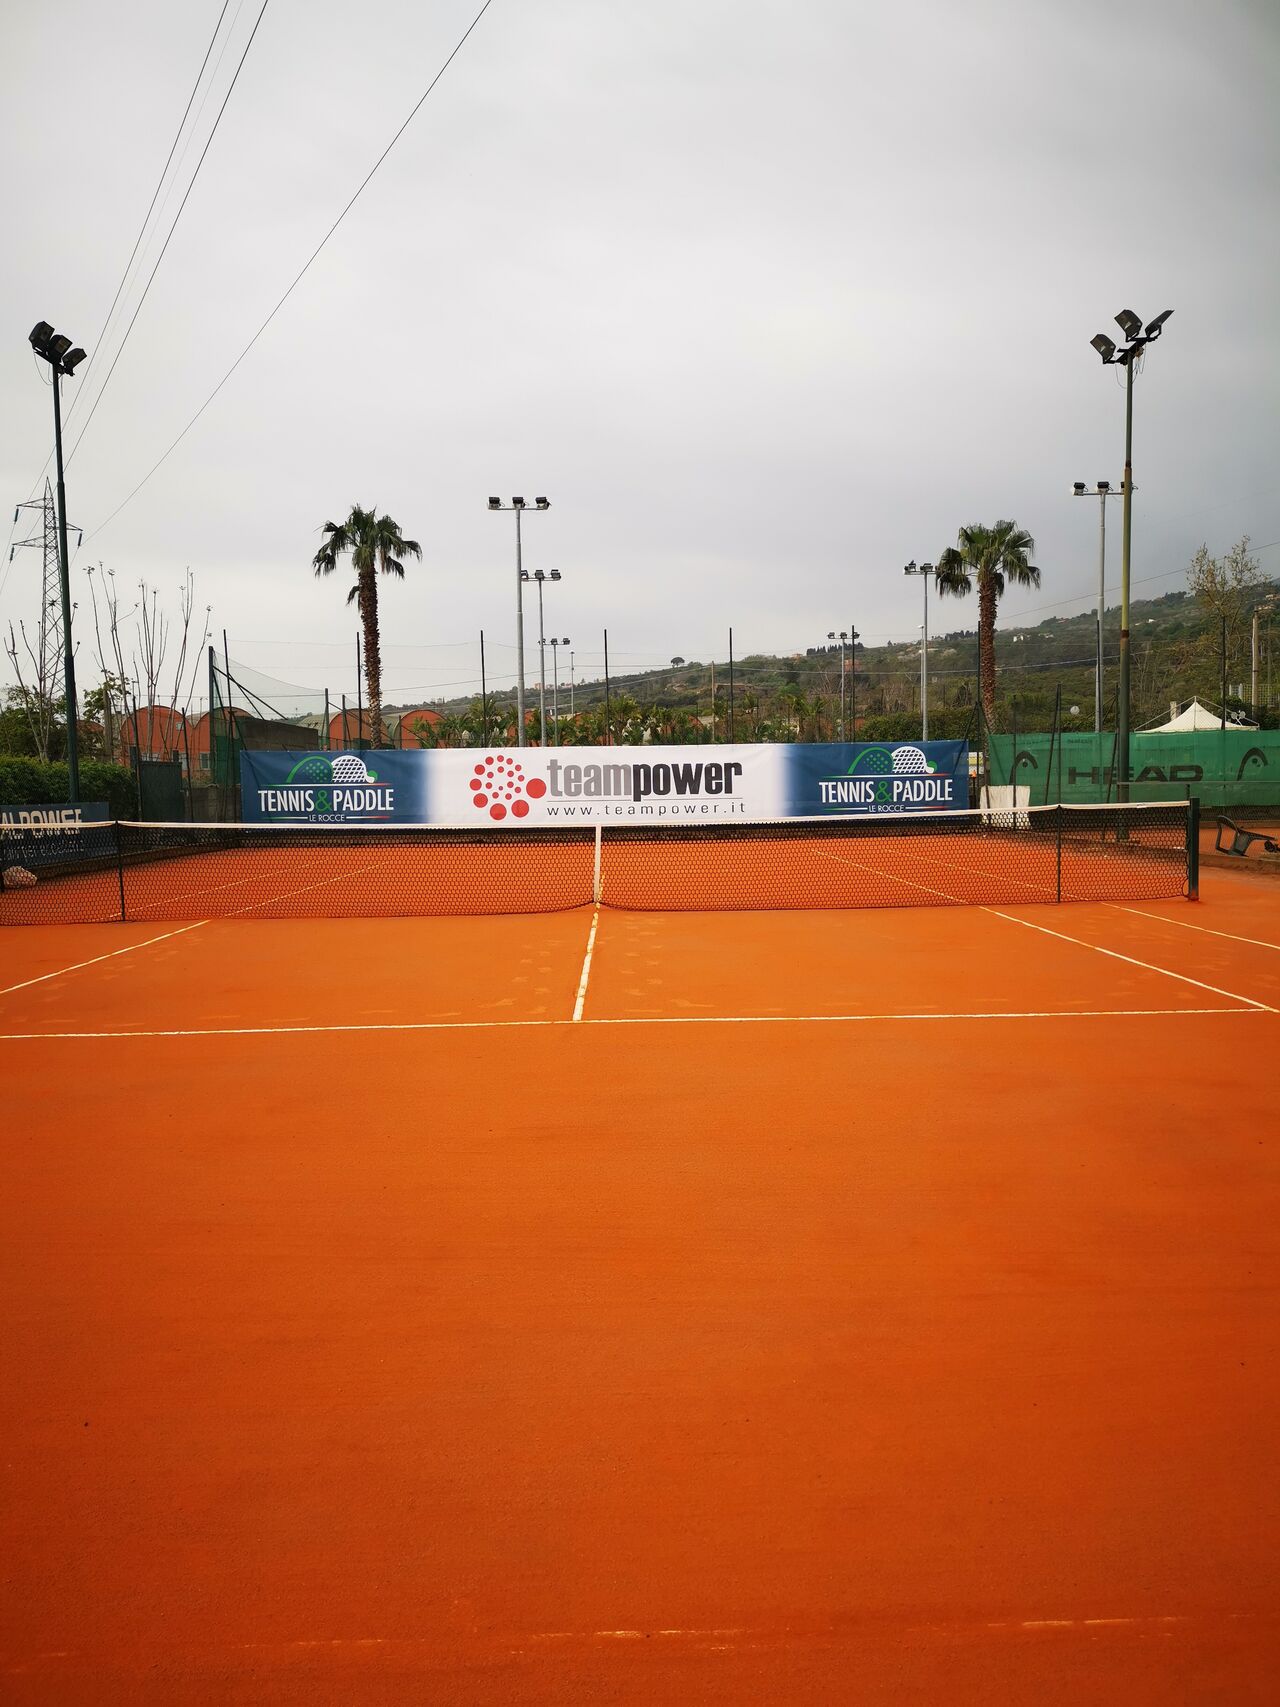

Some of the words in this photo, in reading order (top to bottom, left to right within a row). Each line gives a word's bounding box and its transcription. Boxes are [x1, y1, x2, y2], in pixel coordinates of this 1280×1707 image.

[546, 759, 743, 802] teampower
[1067, 765, 1203, 785] HEAD
[546, 801, 746, 817] www.teampower.it
[868, 805, 877, 813] LE
[877, 804, 905, 813] ROCCE
[308, 814, 318, 823] LE
[318, 814, 346, 823] ROCCE
